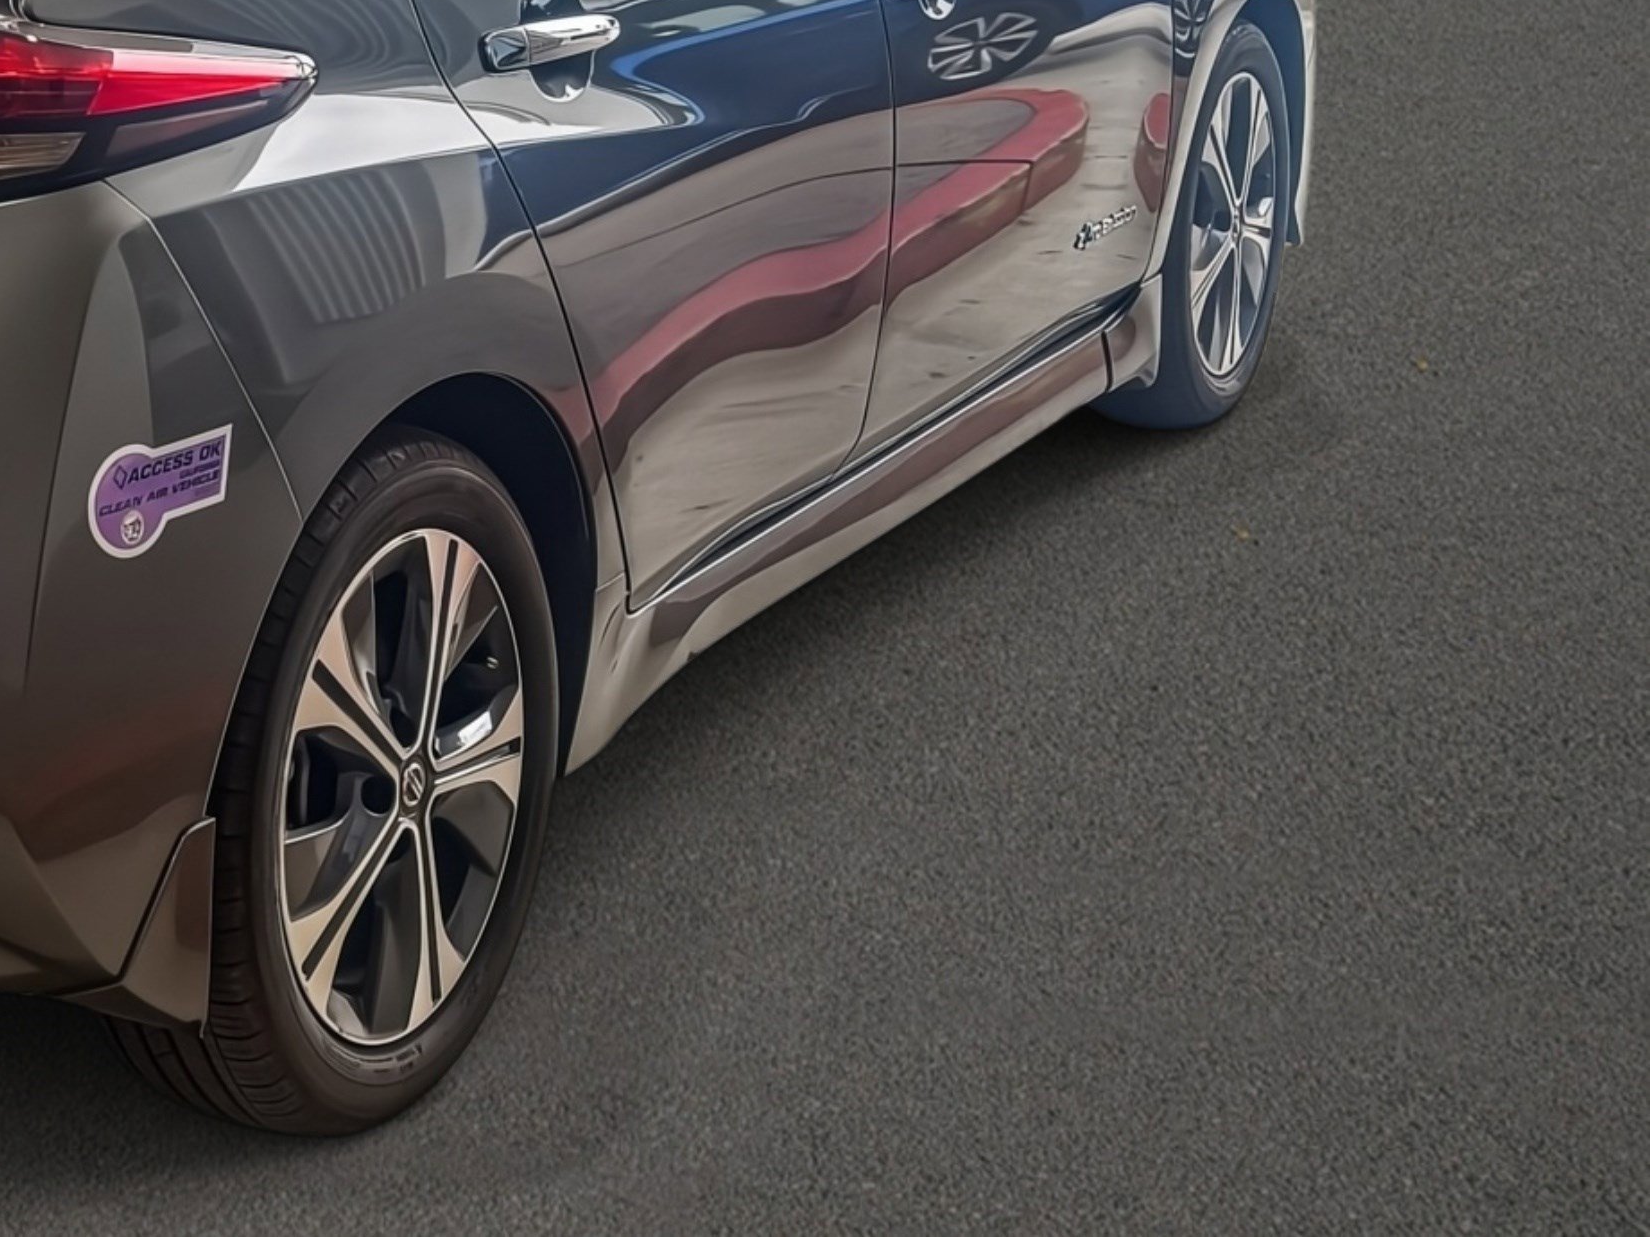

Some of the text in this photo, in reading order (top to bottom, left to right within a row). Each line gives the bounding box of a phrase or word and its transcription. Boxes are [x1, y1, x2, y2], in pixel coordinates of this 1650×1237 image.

[127, 440, 222, 484] ACCESS OK
[99, 495, 143, 517] CLEAN
[147, 487, 169, 502] AIR
[172, 469, 221, 494] VEHICLE
